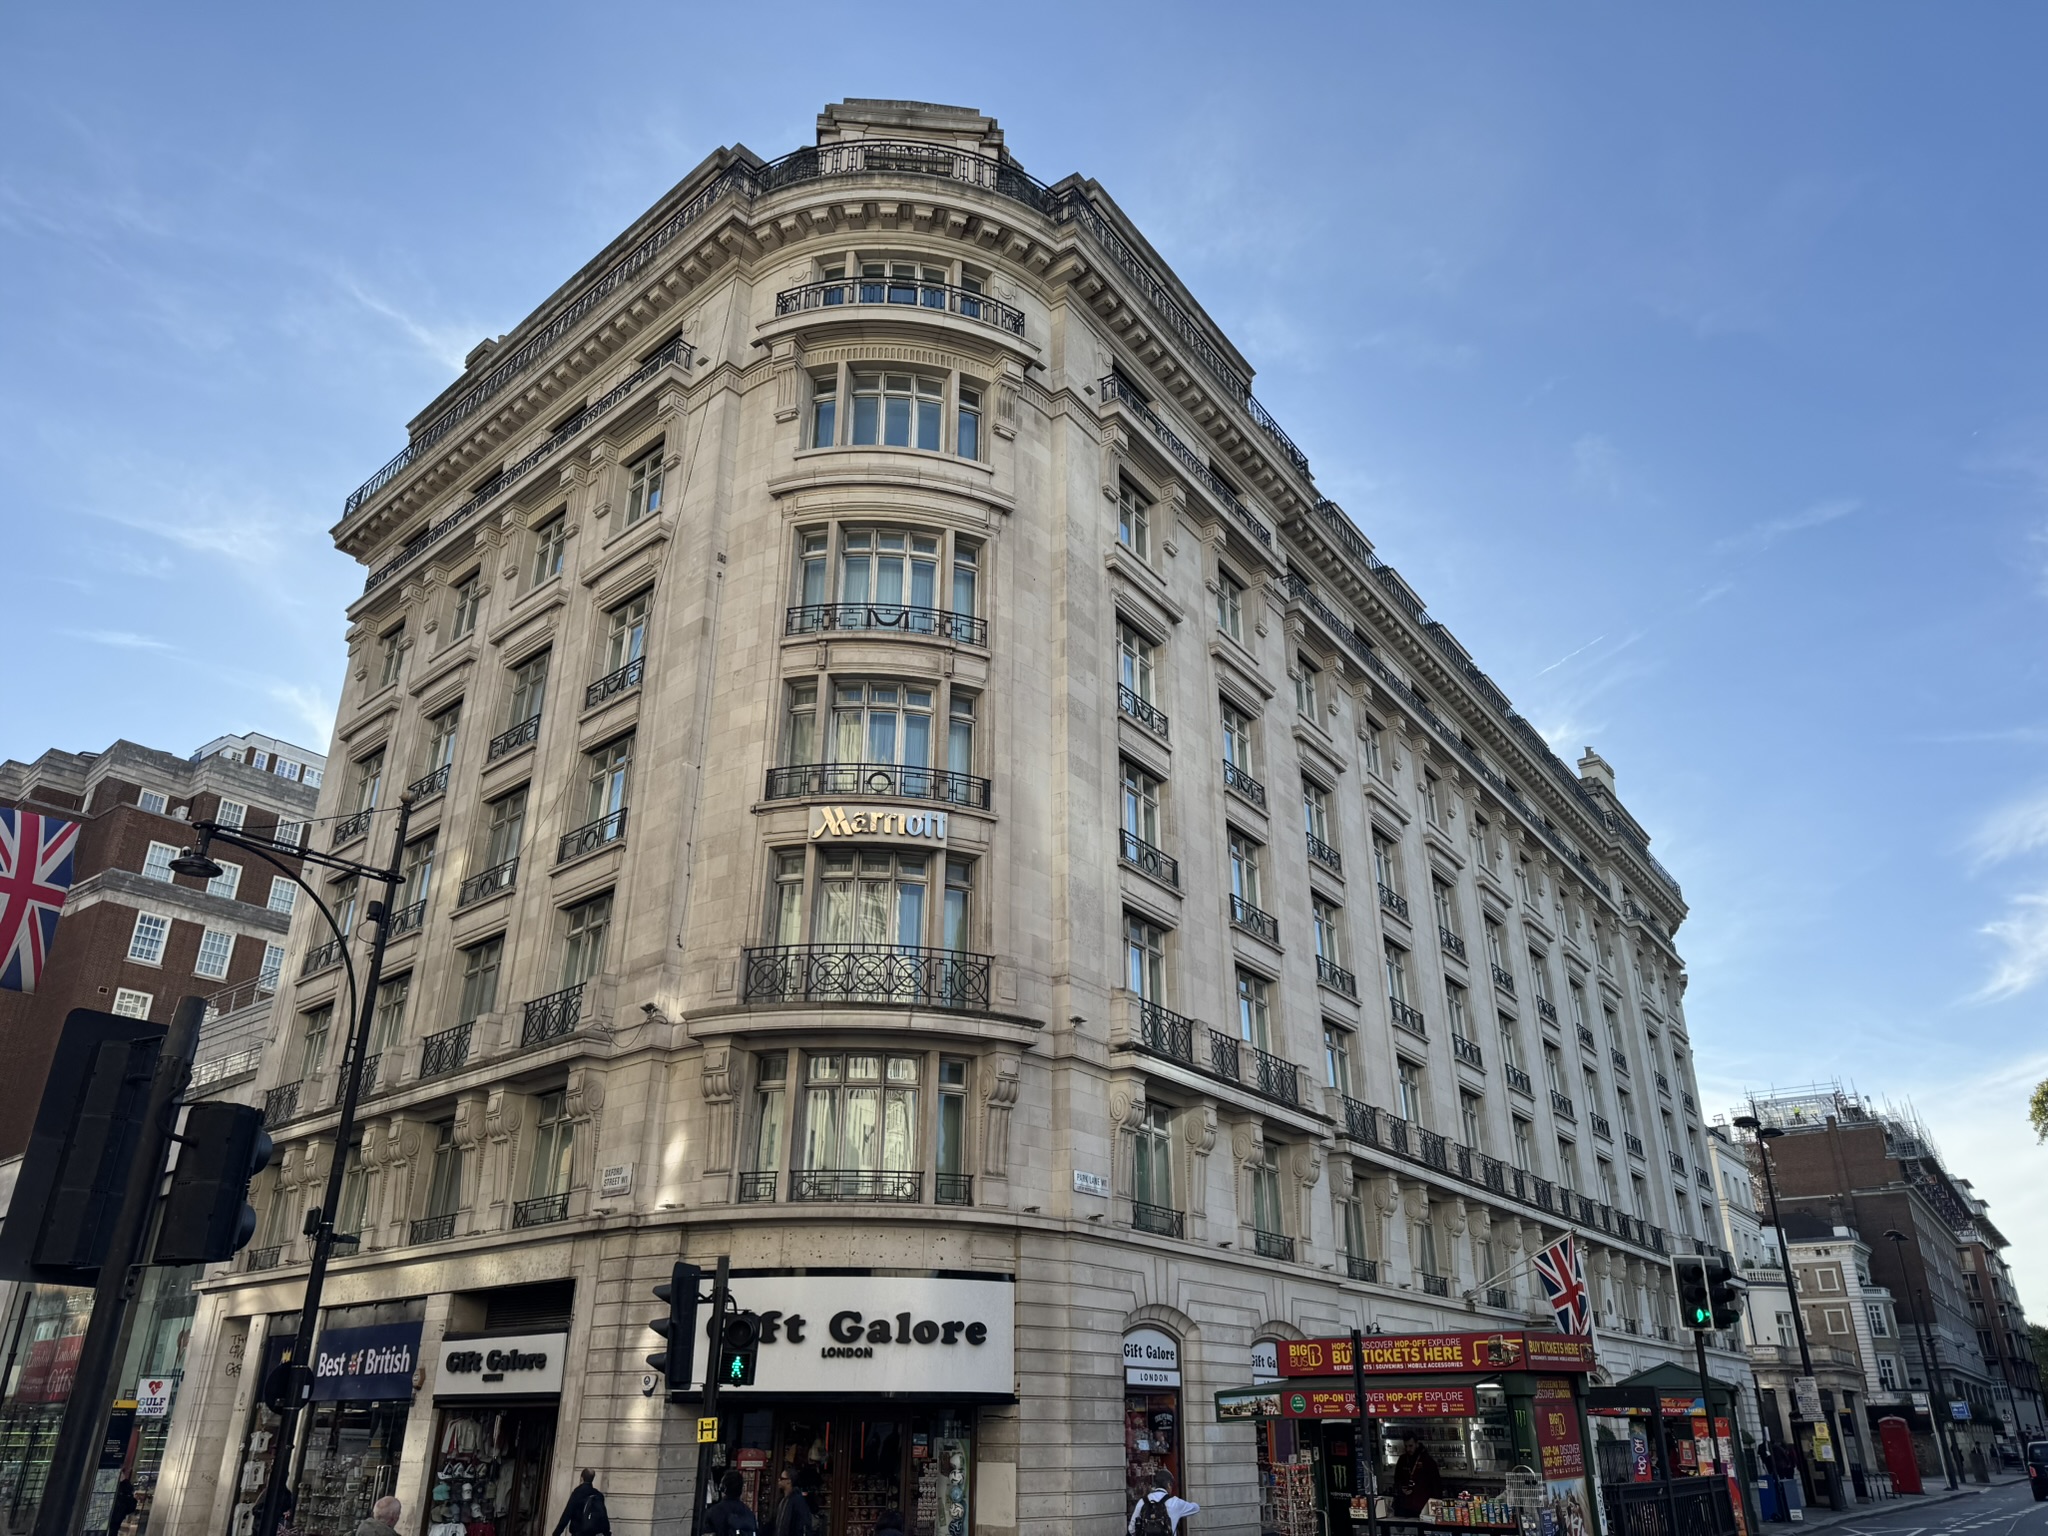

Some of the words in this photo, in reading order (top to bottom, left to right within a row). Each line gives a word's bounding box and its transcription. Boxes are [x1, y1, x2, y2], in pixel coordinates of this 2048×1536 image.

[811, 806, 945, 839] Marriott
[604, 1177, 620, 1187] STREET
[829, 1310, 987, 1345] Galore
[1123, 1343, 1143, 1358] Gift
[1146, 1345, 1175, 1360] Galore
[1289, 1344, 1307, 1356] BIG
[1331, 1342, 1352, 1350] HOP-O
[1394, 1339, 1426, 1348] HOP-OFF
[1427, 1338, 1461, 1347] EXPLORE
[1528, 1340, 1540, 1353] BUY
[1540, 1341, 1564, 1354] TICKETS
[1564, 1343, 1579, 1355] HERE
[821, 1347, 873, 1359] LONDON
[1362, 1347, 1420, 1363] TICKETS
[1423, 1346, 1463, 1361] HERE
[317, 1352, 346, 1378] Best
[364, 1344, 411, 1375] British
[446, 1351, 483, 1373] Gift
[486, 1349, 547, 1372] Galore
[1290, 1356, 1308, 1367] BUS
[1140, 1373, 1168, 1382] LONDON
[138, 1397, 166, 1406] GULF
[1313, 1393, 1344, 1402] HOP-ON
[1386, 1392, 1423, 1402] HOP-OFF
[1424, 1391, 1463, 1401] EXPLORE
[1634, 1437, 1645, 1454] Off
[1636, 1455, 1647, 1475] Hop
